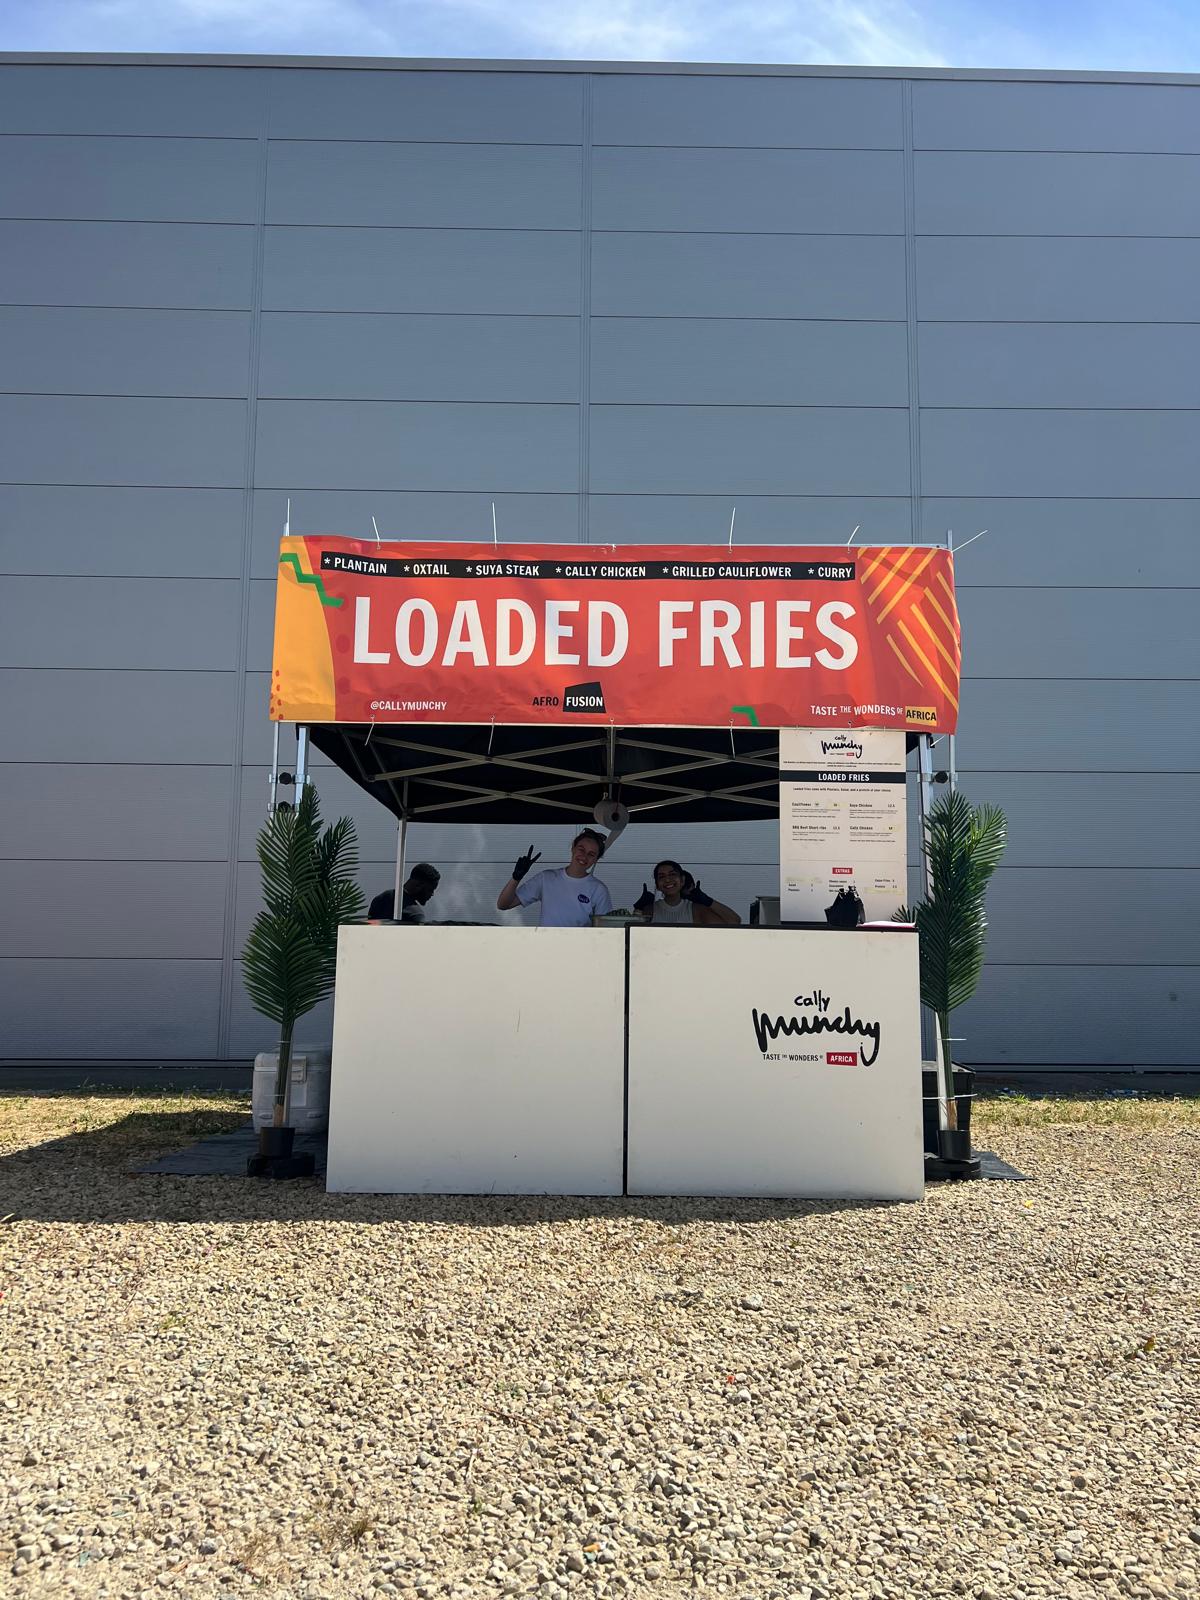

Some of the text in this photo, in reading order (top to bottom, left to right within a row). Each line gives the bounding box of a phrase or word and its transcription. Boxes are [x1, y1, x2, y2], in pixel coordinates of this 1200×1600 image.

[334, 557, 388, 574] PLANTAIN
[413, 564, 450, 575] OXTAIL
[475, 564, 540, 576] SUYA STEAK
[565, 566, 646, 577] CALLY CHICKEN
[672, 566, 792, 578] GRILLED CAULIFLOWER
[817, 566, 852, 578] CURRY
[353, 596, 859, 671] LOADED FRIES
[370, 700, 447, 711] @CALLYMUNCHY
[532, 696, 603, 707] AFRO FUSION
[810, 705, 837, 716] TASTE
[840, 705, 851, 713] THE
[854, 705, 896, 717] WONDERS
[906, 709, 937, 722] AFRICA
[820, 740, 863, 759] munchy
[818, 773, 870, 782] LOADED FRIES
[794, 989, 831, 1013] cally
[752, 1006, 880, 1067] munchy
[762, 1053, 781, 1061] TASTE
[789, 1054, 819, 1062] WONDERS
[830, 1055, 853, 1063] AFRICA
